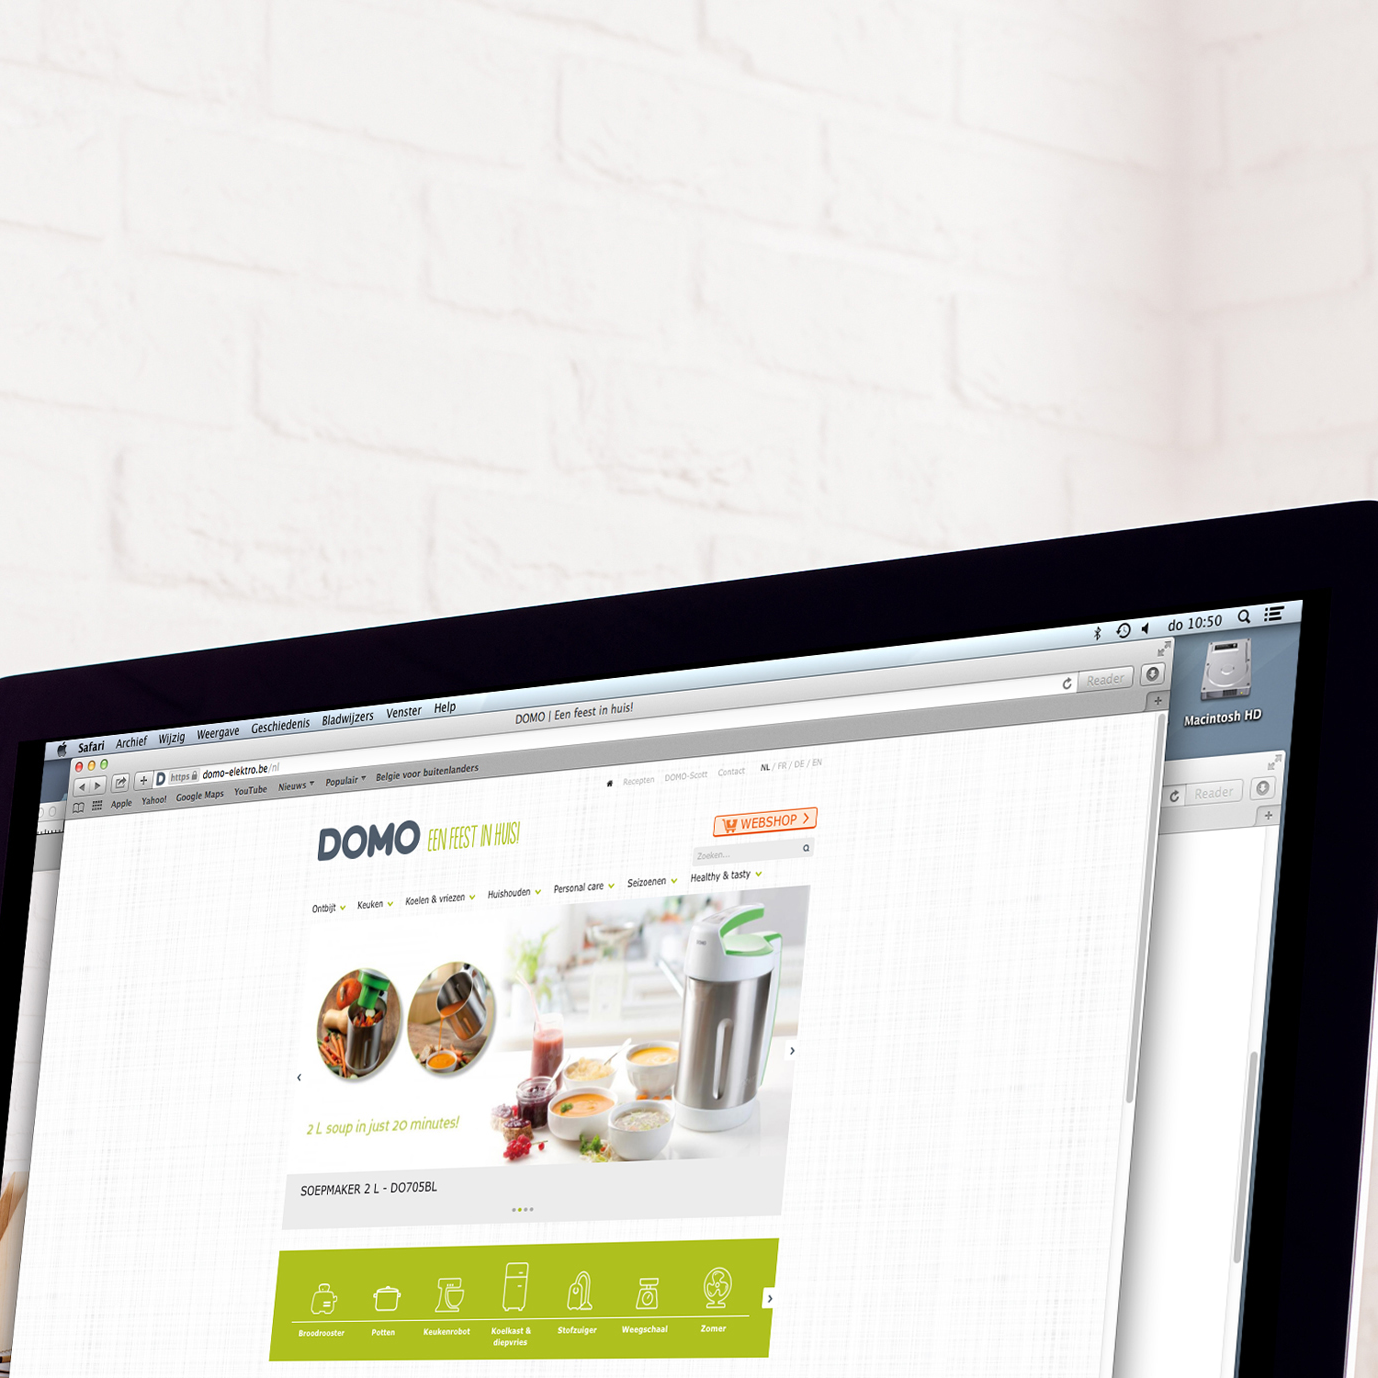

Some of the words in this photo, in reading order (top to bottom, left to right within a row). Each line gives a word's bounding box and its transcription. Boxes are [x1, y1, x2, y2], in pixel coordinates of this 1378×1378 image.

[1168, 618, 1183, 632] do
[1188, 614, 1222, 630] 10:50
[1087, 672, 1125, 687] Reader
[515, 712, 545, 725] DOMO
[554, 709, 571, 721] Een
[573, 706, 596, 719] feest
[599, 705, 608, 716] in
[610, 702, 634, 714] huis!
[1184, 710, 1241, 727] Macintosh
[1244, 708, 1262, 721] HD
[78, 740, 105, 753] Safari
[116, 735, 148, 749] Archief
[158, 731, 185, 745] Wijzig
[197, 726, 240, 740] Weergave
[251, 717, 311, 734] Geschiedenis
[322, 711, 374, 726] Bladwijzers
[387, 705, 422, 719] Venster
[434, 701, 456, 714] Help
[202, 762, 280, 780] domo-elektro.be/nl
[760, 763, 770, 772] NL
[777, 761, 787, 770] FR
[794, 760, 805, 768] DE
[812, 758, 823, 767] EN
[170, 771, 190, 784] https
[623, 775, 655, 787] Recepten
[664, 770, 708, 783] DOMO-Scott
[718, 766, 746, 777] Contact
[111, 799, 132, 810] Apple
[142, 795, 167, 806] Yahoo!
[176, 790, 203, 803] Google
[205, 789, 224, 801] Maps
[234, 784, 267, 797] YouTube
[278, 780, 307, 792] Nieuws
[325, 775, 358, 788] Populair
[376, 770, 400, 783] Belgie
[403, 769, 421, 779] voor
[423, 763, 479, 777] buitenlanders
[1195, 785, 1233, 800] Reader
[740, 814, 797, 830] WEBSHOP
[317, 820, 421, 861] DOMO
[427, 828, 448, 852] EEN
[449, 825, 478, 850] FEEST
[480, 824, 493, 847] IN
[494, 821, 521, 846] HUIS!
[312, 903, 337, 914] Ontbijt
[357, 900, 384, 910] Keuken
[405, 896, 429, 906] Koelen
[431, 894, 437, 904] &
[439, 893, 465, 903] vriezen
[488, 888, 531, 899] Huishouden
[554, 883, 586, 894] Personal
[587, 882, 604, 891] care
[627, 876, 667, 888] Seizoenen
[691, 871, 721, 883] Healthy
[723, 870, 729, 880] &
[731, 869, 751, 881] tasty
[306, 1124, 313, 1136] 2
[316, 1122, 322, 1135] L
[326, 1121, 353, 1136] soup
[356, 1118, 366, 1133] in
[366, 1117, 390, 1136] just
[392, 1120, 408, 1132] 20
[410, 1115, 460, 1130] minutes!
[300, 1184, 361, 1197] SOEPMAKER
[364, 1183, 371, 1195] 2
[373, 1183, 379, 1194] L
[390, 1181, 437, 1193] DO705BL
[298, 1329, 345, 1337] Broodrooster
[371, 1328, 395, 1336] Potten
[423, 1327, 471, 1336] Keukenrobot
[491, 1326, 524, 1335] Koelkast
[525, 1326, 531, 1334] &
[557, 1326, 597, 1336] Stofzuiger
[622, 1325, 668, 1336] Weegschaal
[700, 1324, 727, 1333] Zomer
[493, 1338, 527, 1347] diepvries
